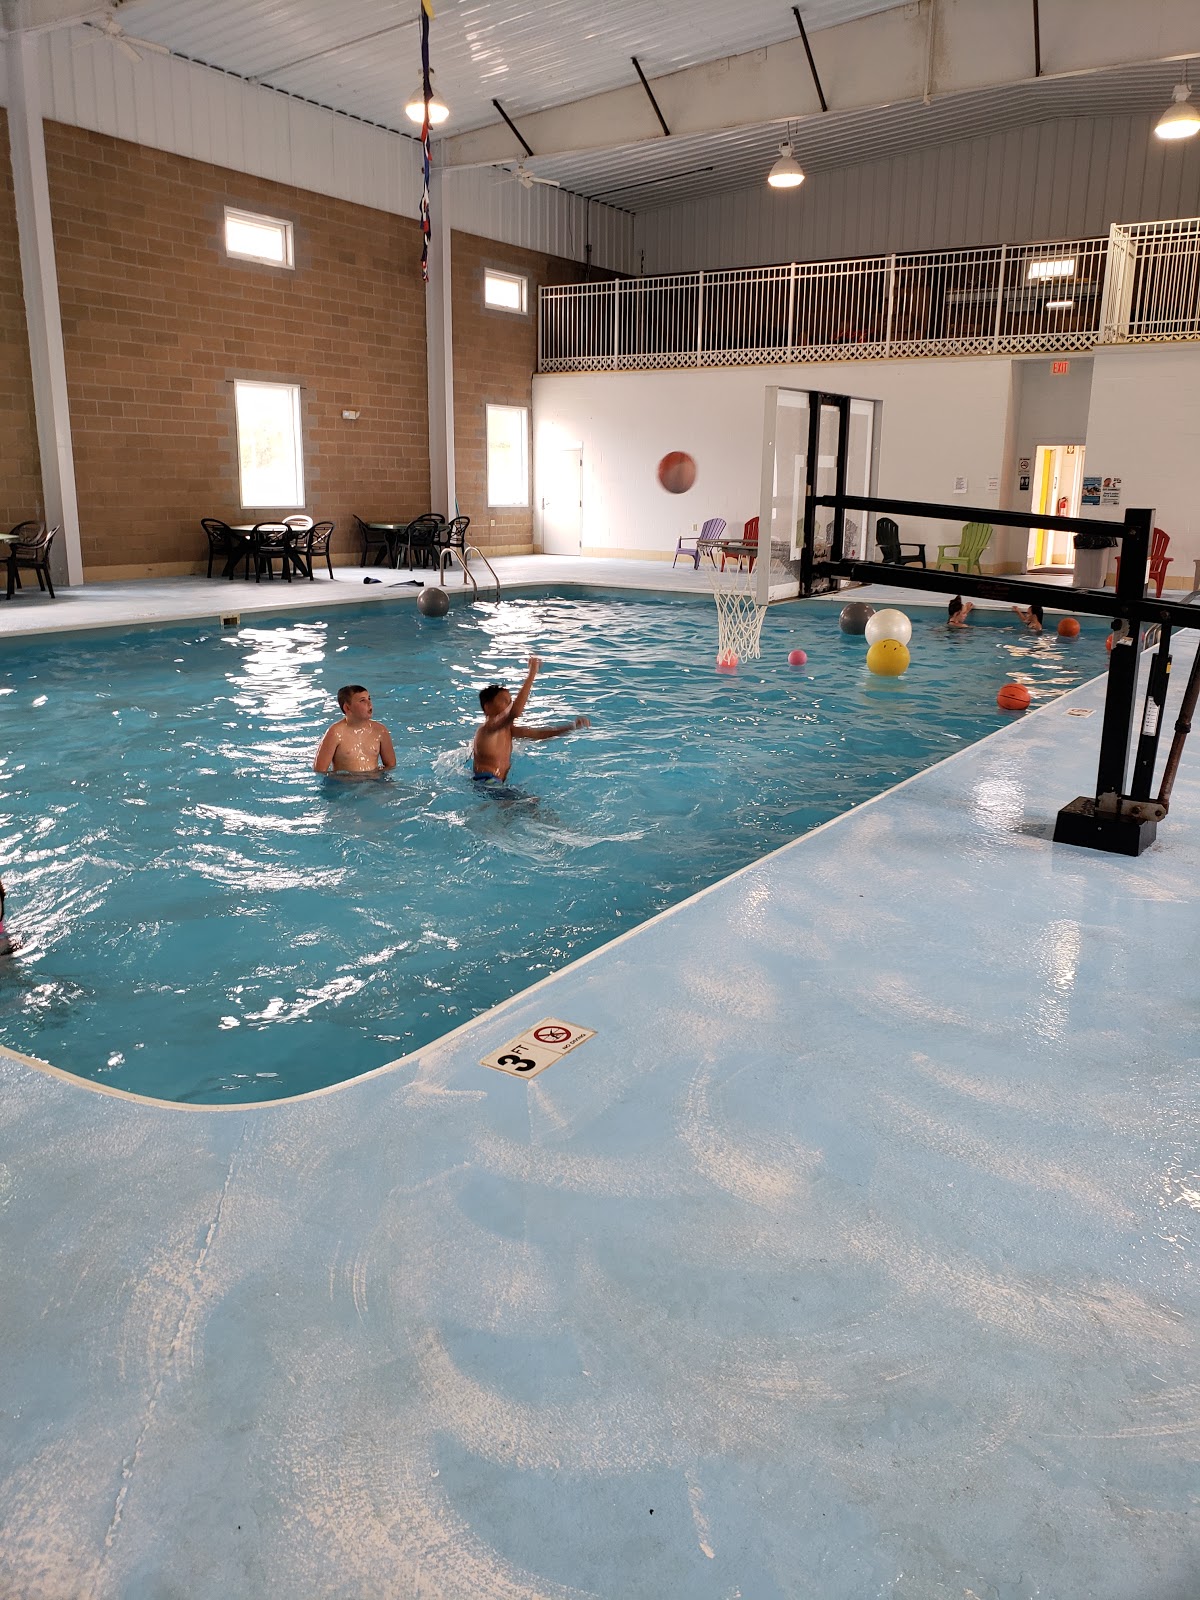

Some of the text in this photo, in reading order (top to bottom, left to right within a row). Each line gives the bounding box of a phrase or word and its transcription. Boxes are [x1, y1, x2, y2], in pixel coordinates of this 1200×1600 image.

[1053, 361, 1069, 374] EXIT
[569, 1033, 586, 1045] DIVING
[497, 1044, 536, 1072] 3 FT
